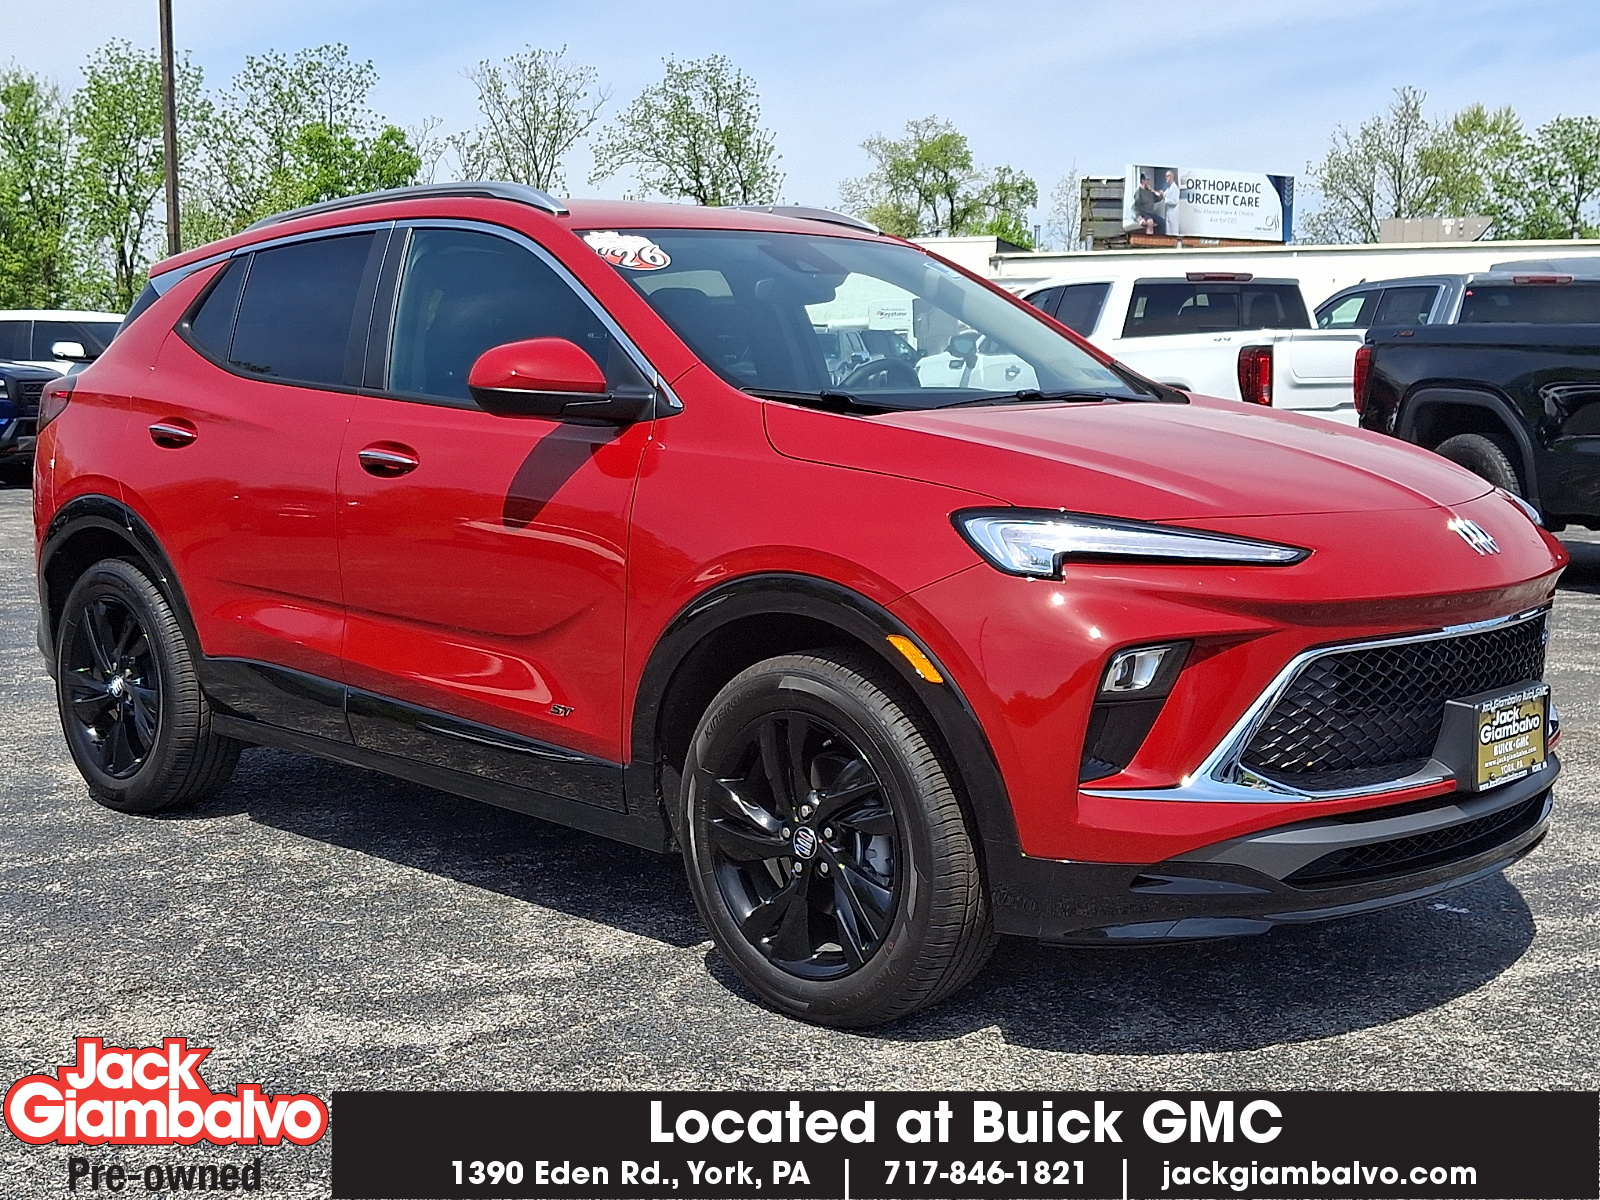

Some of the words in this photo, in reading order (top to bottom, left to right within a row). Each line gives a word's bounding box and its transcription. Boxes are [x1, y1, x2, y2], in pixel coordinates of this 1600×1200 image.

[1186, 178, 1262, 194] ORTHOPAEDIC
[1187, 192, 1231, 206] URGENT
[1232, 195, 1261, 208] CARE
[550, 703, 575, 717] ST
[1492, 706, 1520, 726] Jack
[1480, 716, 1540, 744] Giambalvo
